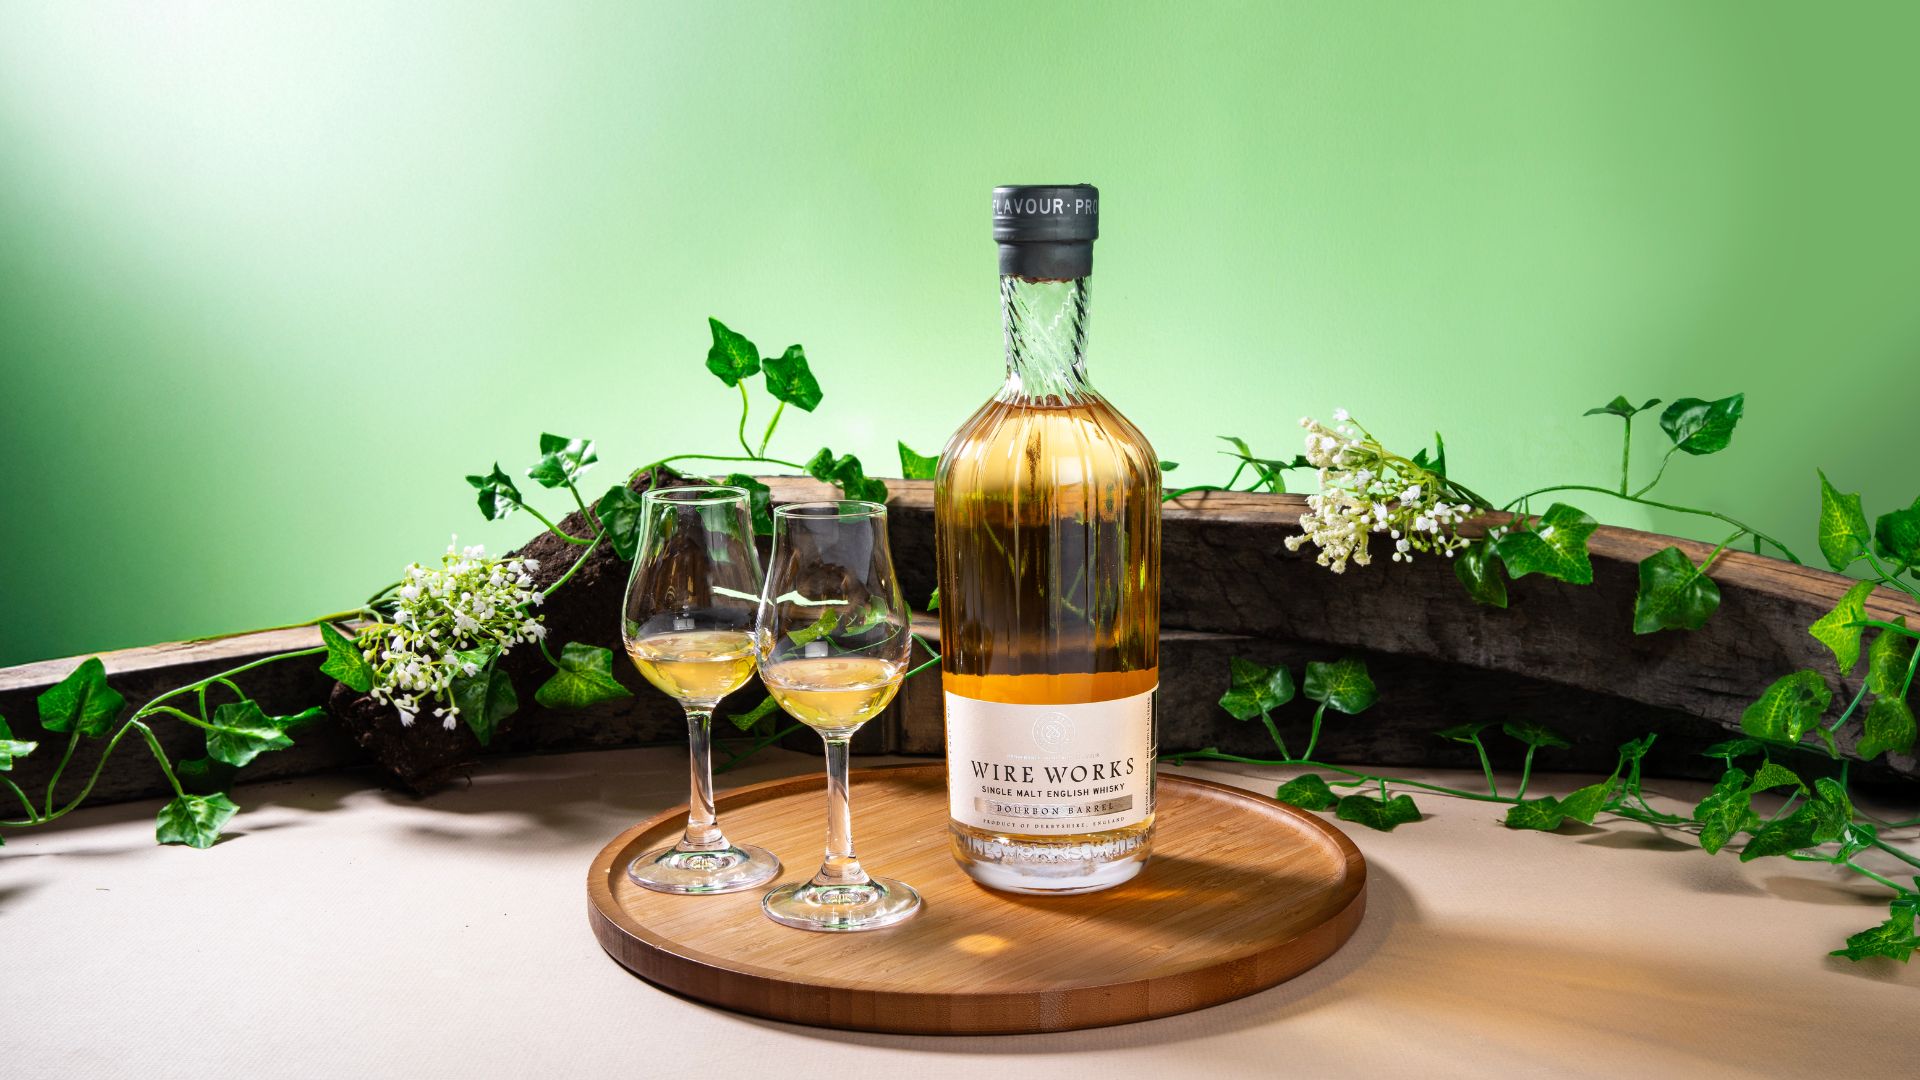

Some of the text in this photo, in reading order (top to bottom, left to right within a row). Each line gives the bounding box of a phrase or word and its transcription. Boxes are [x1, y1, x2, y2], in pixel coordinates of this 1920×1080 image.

[971, 757, 1134, 784] WIRE WORKS
[981, 782, 1125, 798] SINGLE MALT ENGLISH WHISKY
[996, 802, 1113, 815] BOURBON BARREL
[983, 818, 1016, 828] PRODUCT
[1092, 816, 1125, 827] ENGLAND
